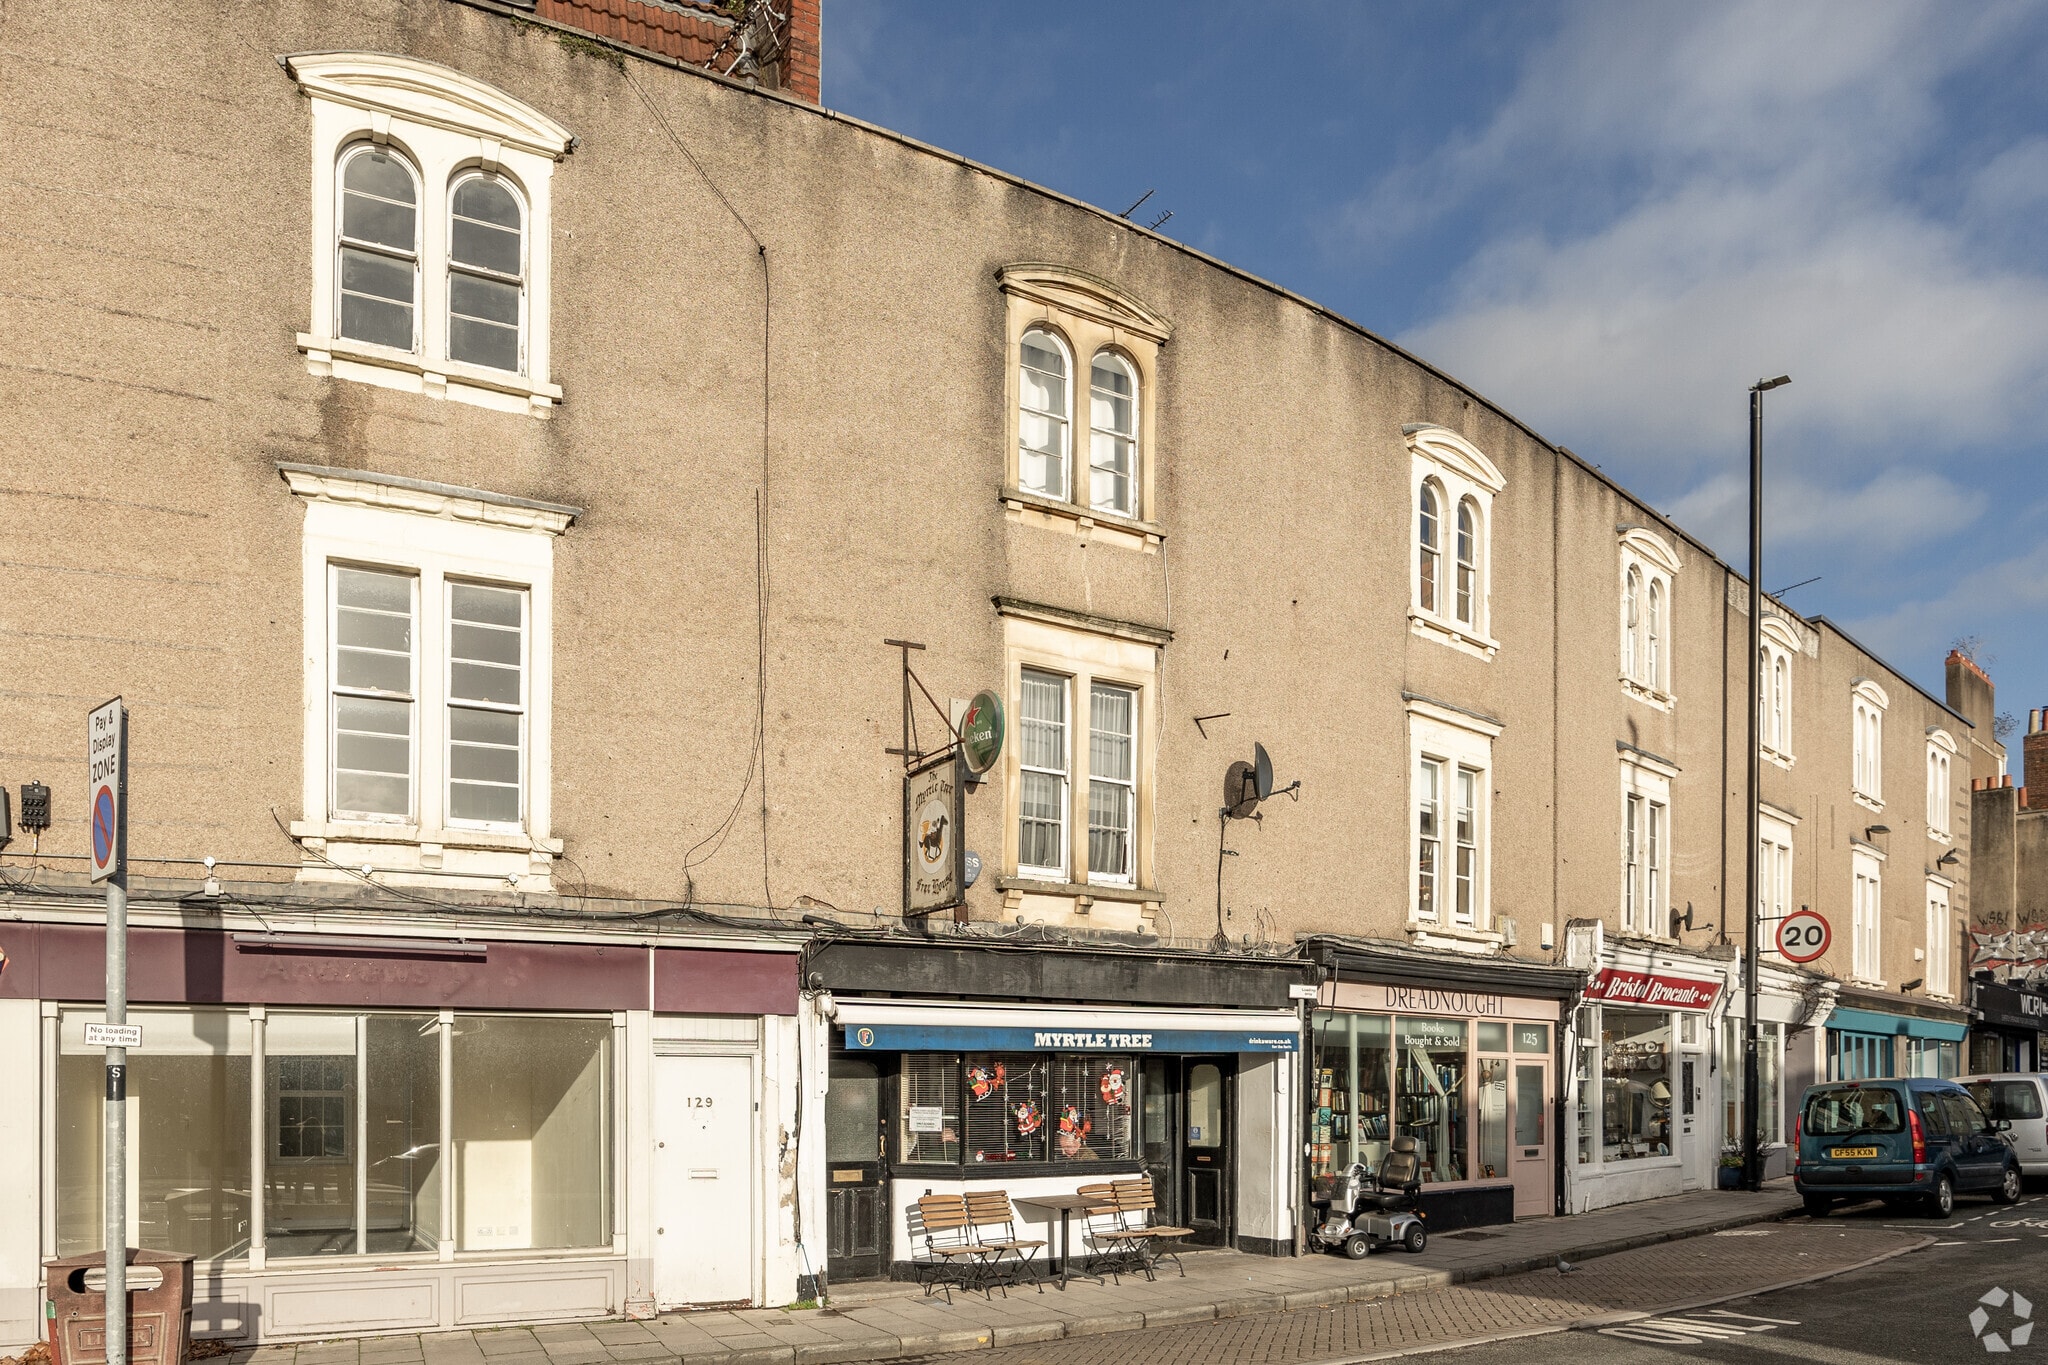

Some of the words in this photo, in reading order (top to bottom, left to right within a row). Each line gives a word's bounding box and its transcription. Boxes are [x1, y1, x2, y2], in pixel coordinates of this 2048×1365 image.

[95, 716, 107, 732] Pay
[109, 709, 113, 724] &
[93, 732, 115, 754] Display
[92, 753, 115, 784] ZONE
[928, 770, 938, 783] The
[915, 781, 939, 813] Myrtle
[940, 779, 954, 796] Tree
[916, 878, 931, 895] Free
[932, 871, 953, 897] House
[1785, 925, 1823, 946] 20
[1604, 976, 1654, 999] Bristol
[1646, 982, 1700, 1004] Brocante
[1385, 985, 1503, 1015] DREADNOUGHT
[90, 1026, 103, 1034] No
[105, 1027, 137, 1036] loading
[1421, 1022, 1445, 1033] Books
[861, 1031, 870, 1044] F
[1034, 1032, 1107, 1048] MYRTLE
[1108, 1033, 1153, 1048] TREE
[1404, 1034, 1433, 1048] Bought
[1434, 1036, 1442, 1046] &
[1443, 1036, 1460, 1047] Sold
[1522, 1032, 1538, 1046] 125
[687, 1097, 713, 1108] 129
[1834, 1148, 1856, 1157] CF55
[1856, 1148, 1874, 1156] KXN
[1597, 1309, 1802, 1345] ONLY
